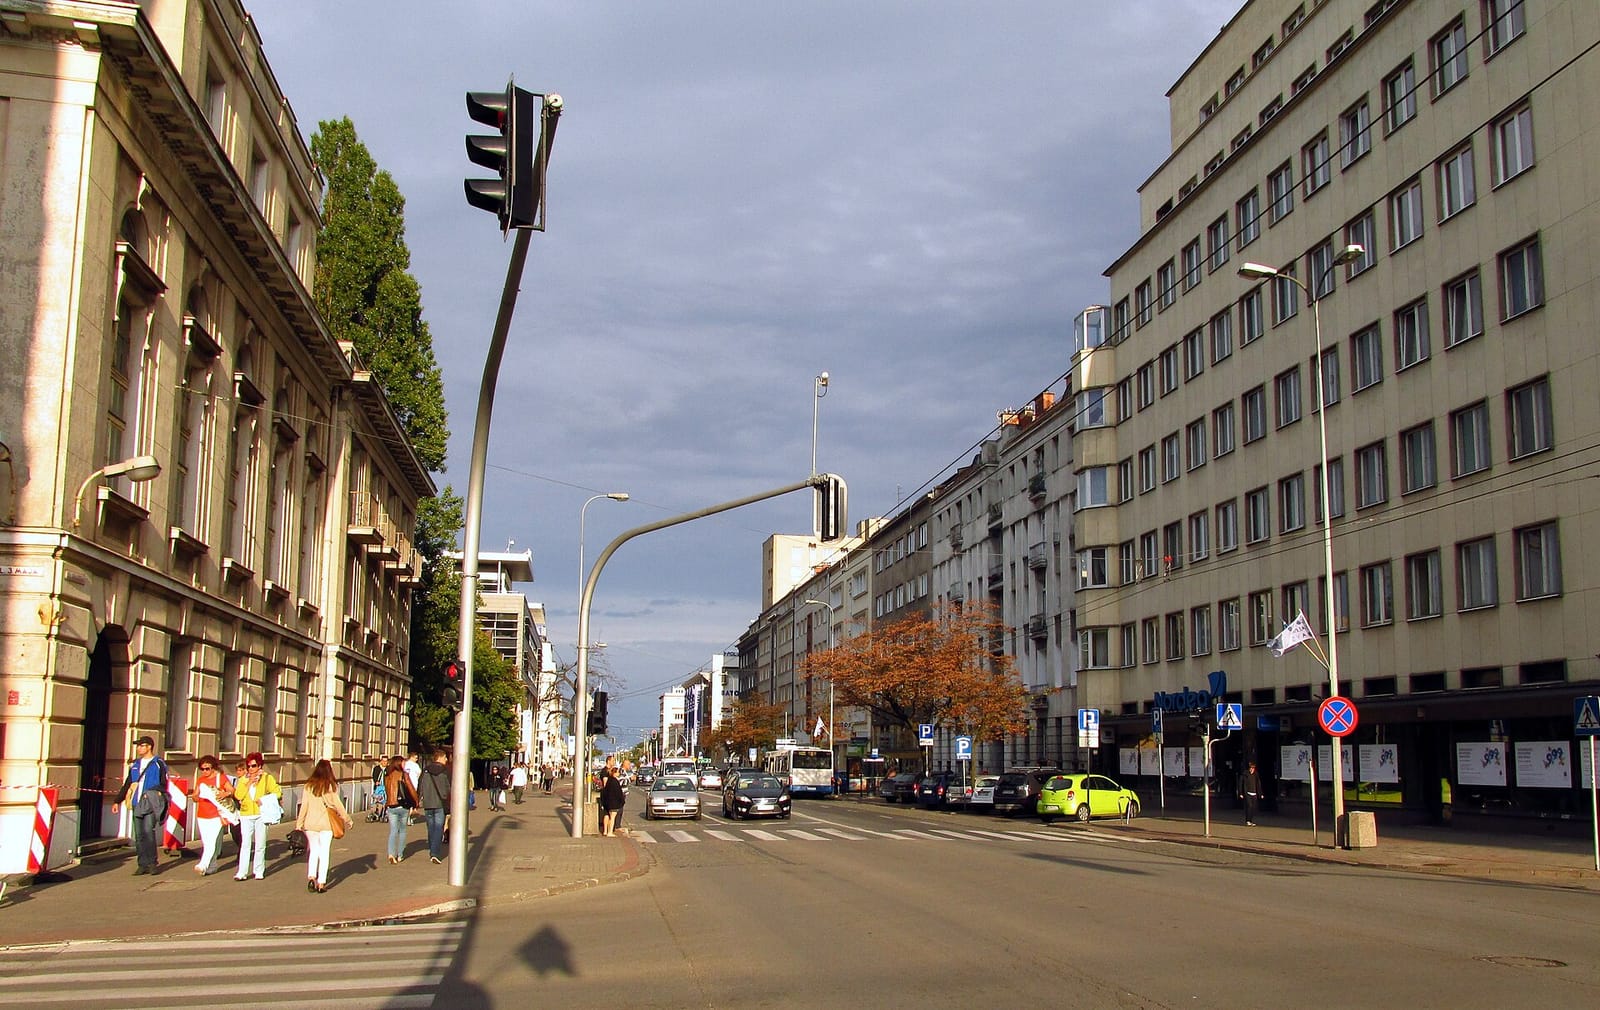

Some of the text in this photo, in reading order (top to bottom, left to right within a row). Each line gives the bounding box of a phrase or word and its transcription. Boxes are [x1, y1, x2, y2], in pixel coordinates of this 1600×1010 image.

[1154, 687, 1209, 710] Nordea
[1083, 712, 1095, 728] P
[1153, 711, 1160, 726] P
[922, 726, 931, 737] P
[958, 741, 969, 753] P
